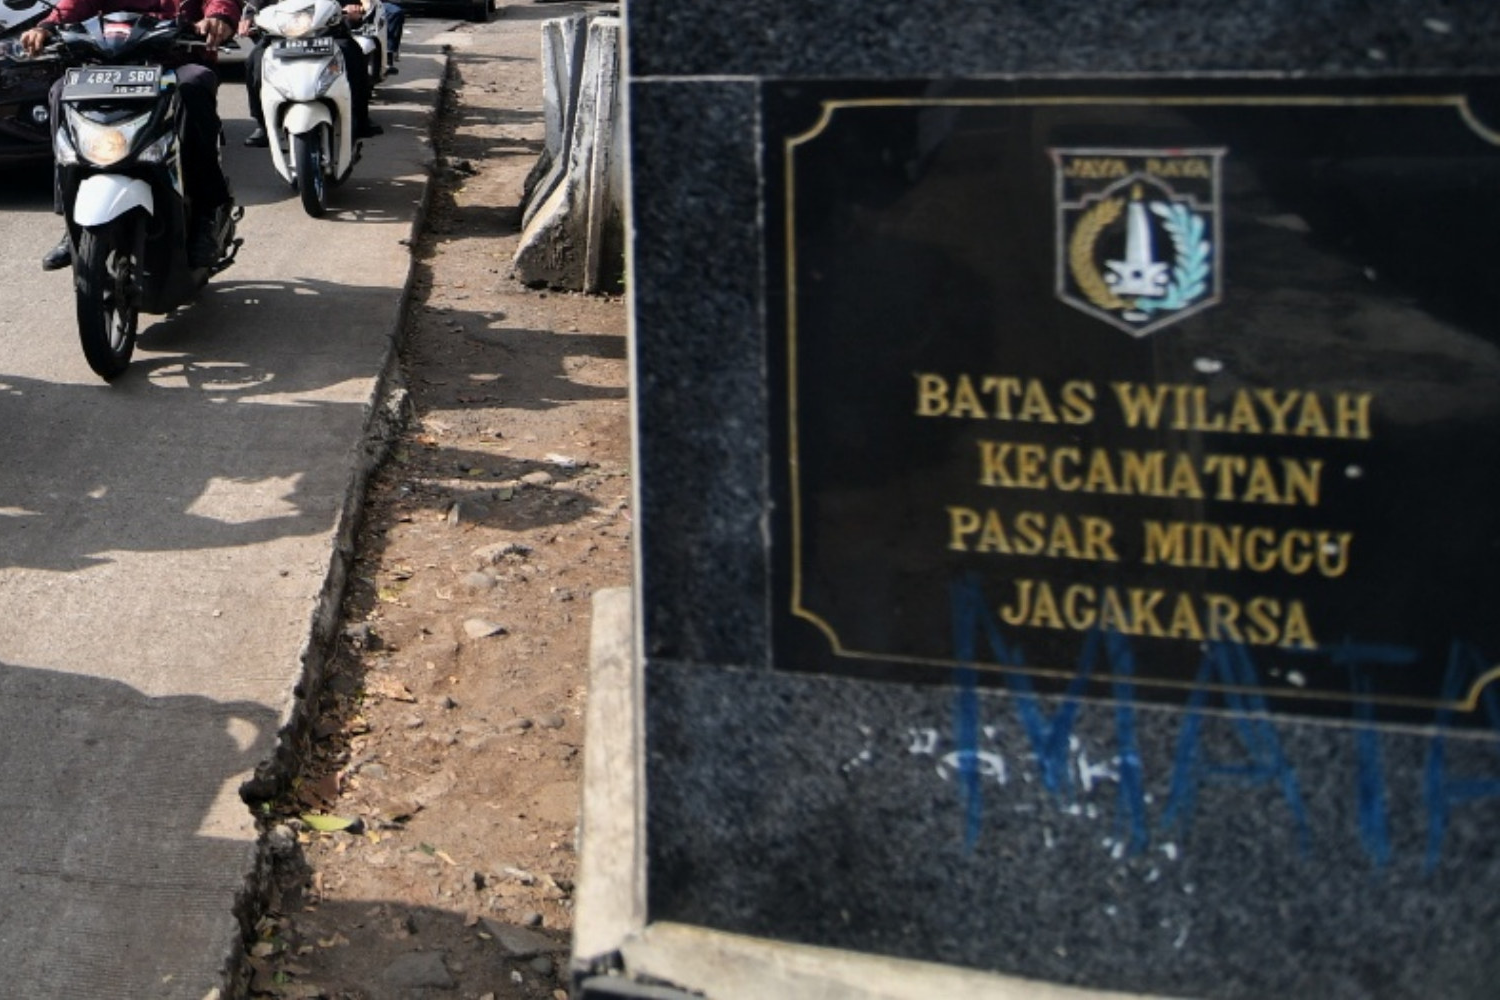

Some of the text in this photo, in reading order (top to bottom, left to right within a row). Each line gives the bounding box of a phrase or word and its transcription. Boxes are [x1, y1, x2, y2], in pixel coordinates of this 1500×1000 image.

[1065, 158, 1211, 178] JAYA RAYA
[913, 373, 1373, 439] BATAS WILAYAH
[976, 439, 1323, 506] KECAMATAN
[946, 506, 1353, 577] PASAR MINGGU
[1001, 578, 1319, 650] JAGAKARSA
